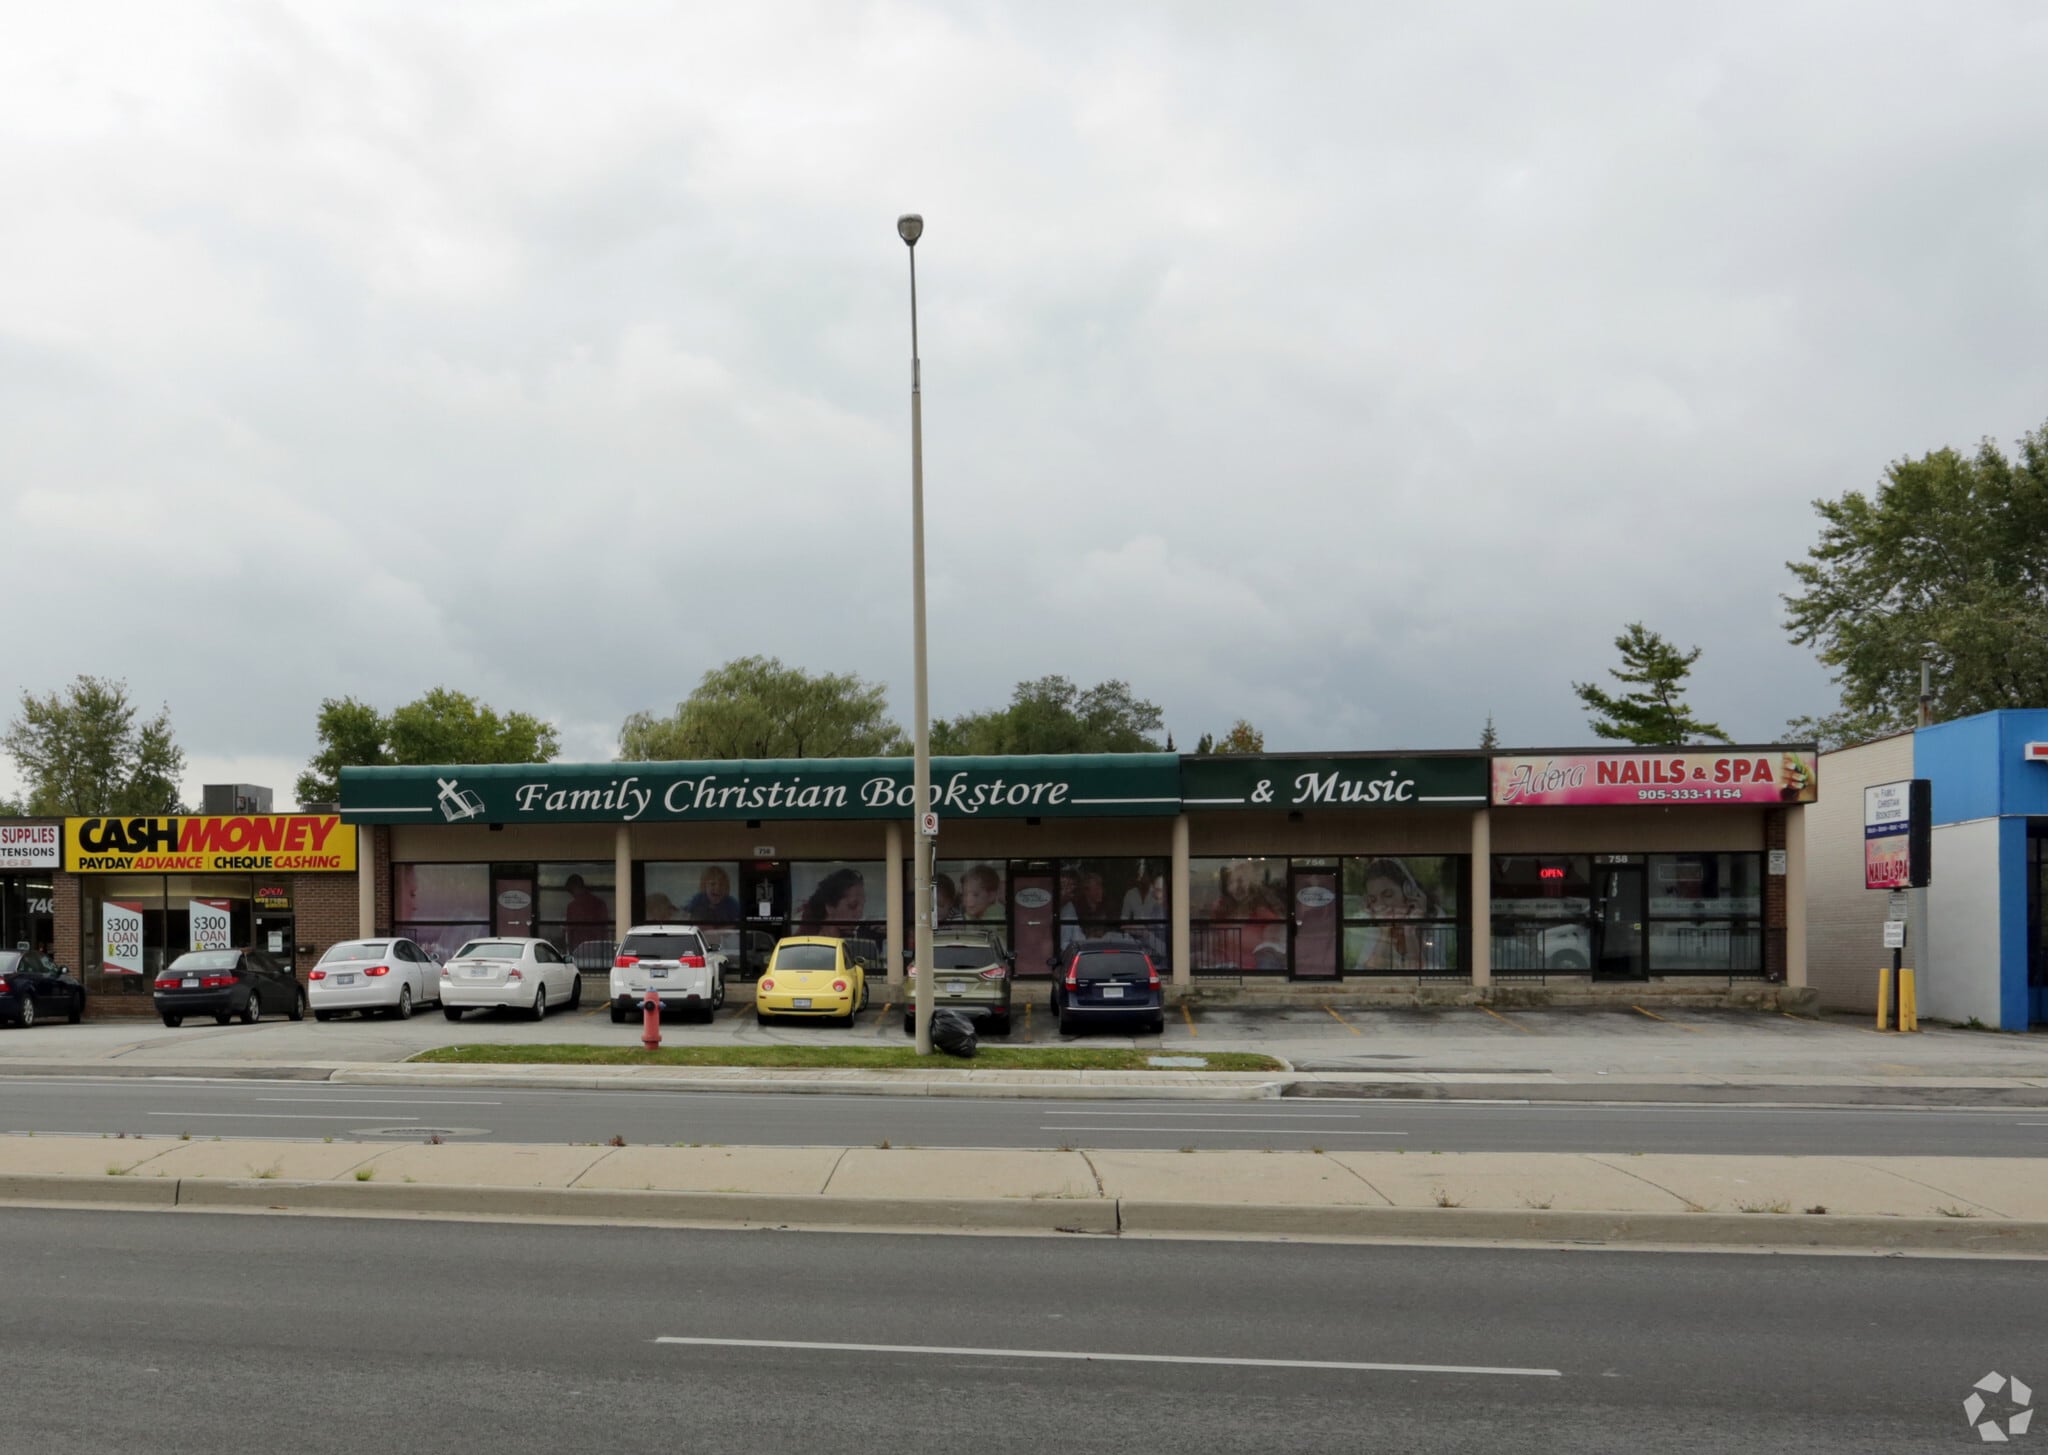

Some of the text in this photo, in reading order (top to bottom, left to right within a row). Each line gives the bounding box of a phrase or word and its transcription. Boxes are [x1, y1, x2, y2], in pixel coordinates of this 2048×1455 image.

[1503, 758, 1774, 800] Adora NAILS & SPA
[1251, 770, 1415, 803] & Music
[515, 777, 651, 820] Family
[664, 776, 848, 812] Christian
[1638, 789, 1742, 800] 905-333-1154
[2, 828, 55, 844] SUPPLIES
[0, 847, 55, 857] TENSIONS
[79, 855, 341, 869] PAYDAY ADVANCE CHEQUE CASHING
[1540, 867, 1564, 878] OPEN
[1869, 862, 1889, 881] NAILS
[1895, 859, 1908, 880] SPA
[107, 918, 139, 932] $300
[194, 916, 226, 930] $300
[107, 932, 139, 943] LOAN
[194, 931, 226, 941] LOAN
[115, 944, 138, 958] $20
